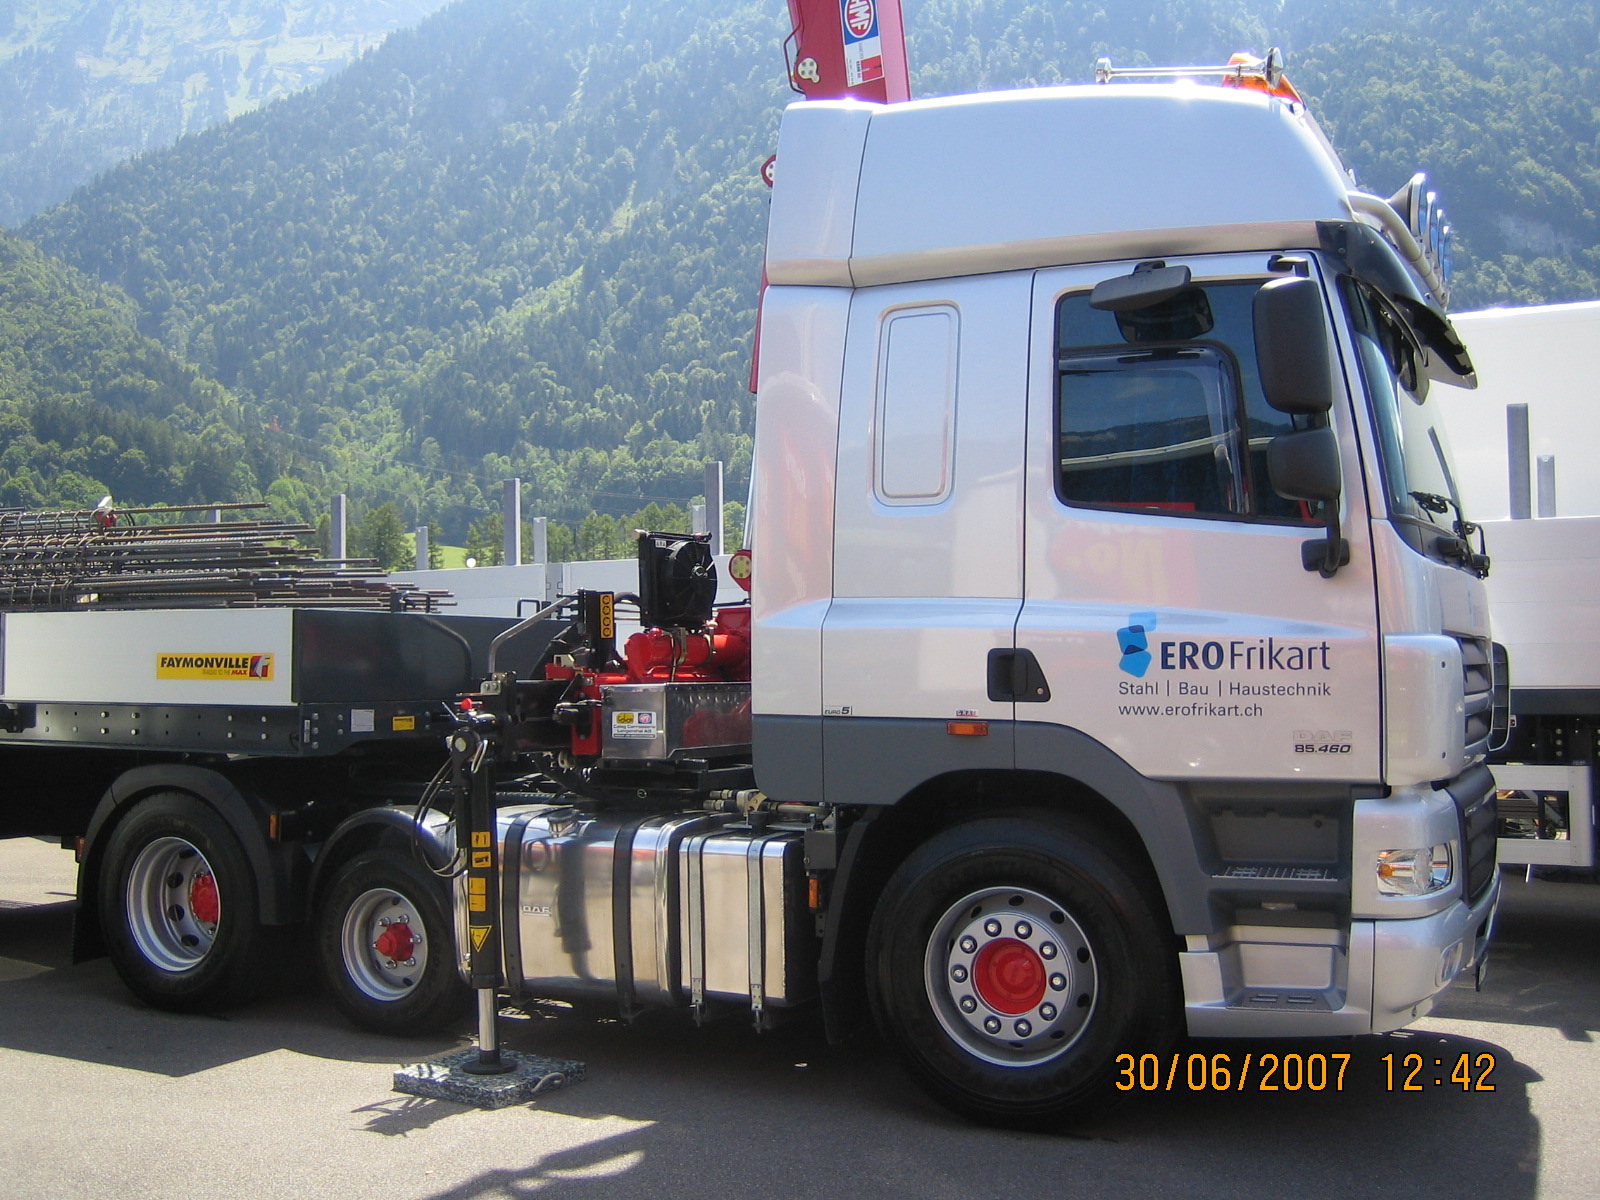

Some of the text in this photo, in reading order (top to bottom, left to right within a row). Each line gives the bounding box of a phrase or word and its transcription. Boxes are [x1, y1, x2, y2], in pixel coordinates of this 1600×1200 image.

[160, 657, 249, 668] FAYMONVILLE
[1118, 682, 1332, 696] Stahl Bau Haustechnik
[841, 706, 850, 714] 5
[1118, 703, 1264, 717] www.erofrikart.ch
[1293, 730, 1352, 741] DAF
[1294, 744, 1351, 753] 85.460
[523, 905, 551, 914] DAF
